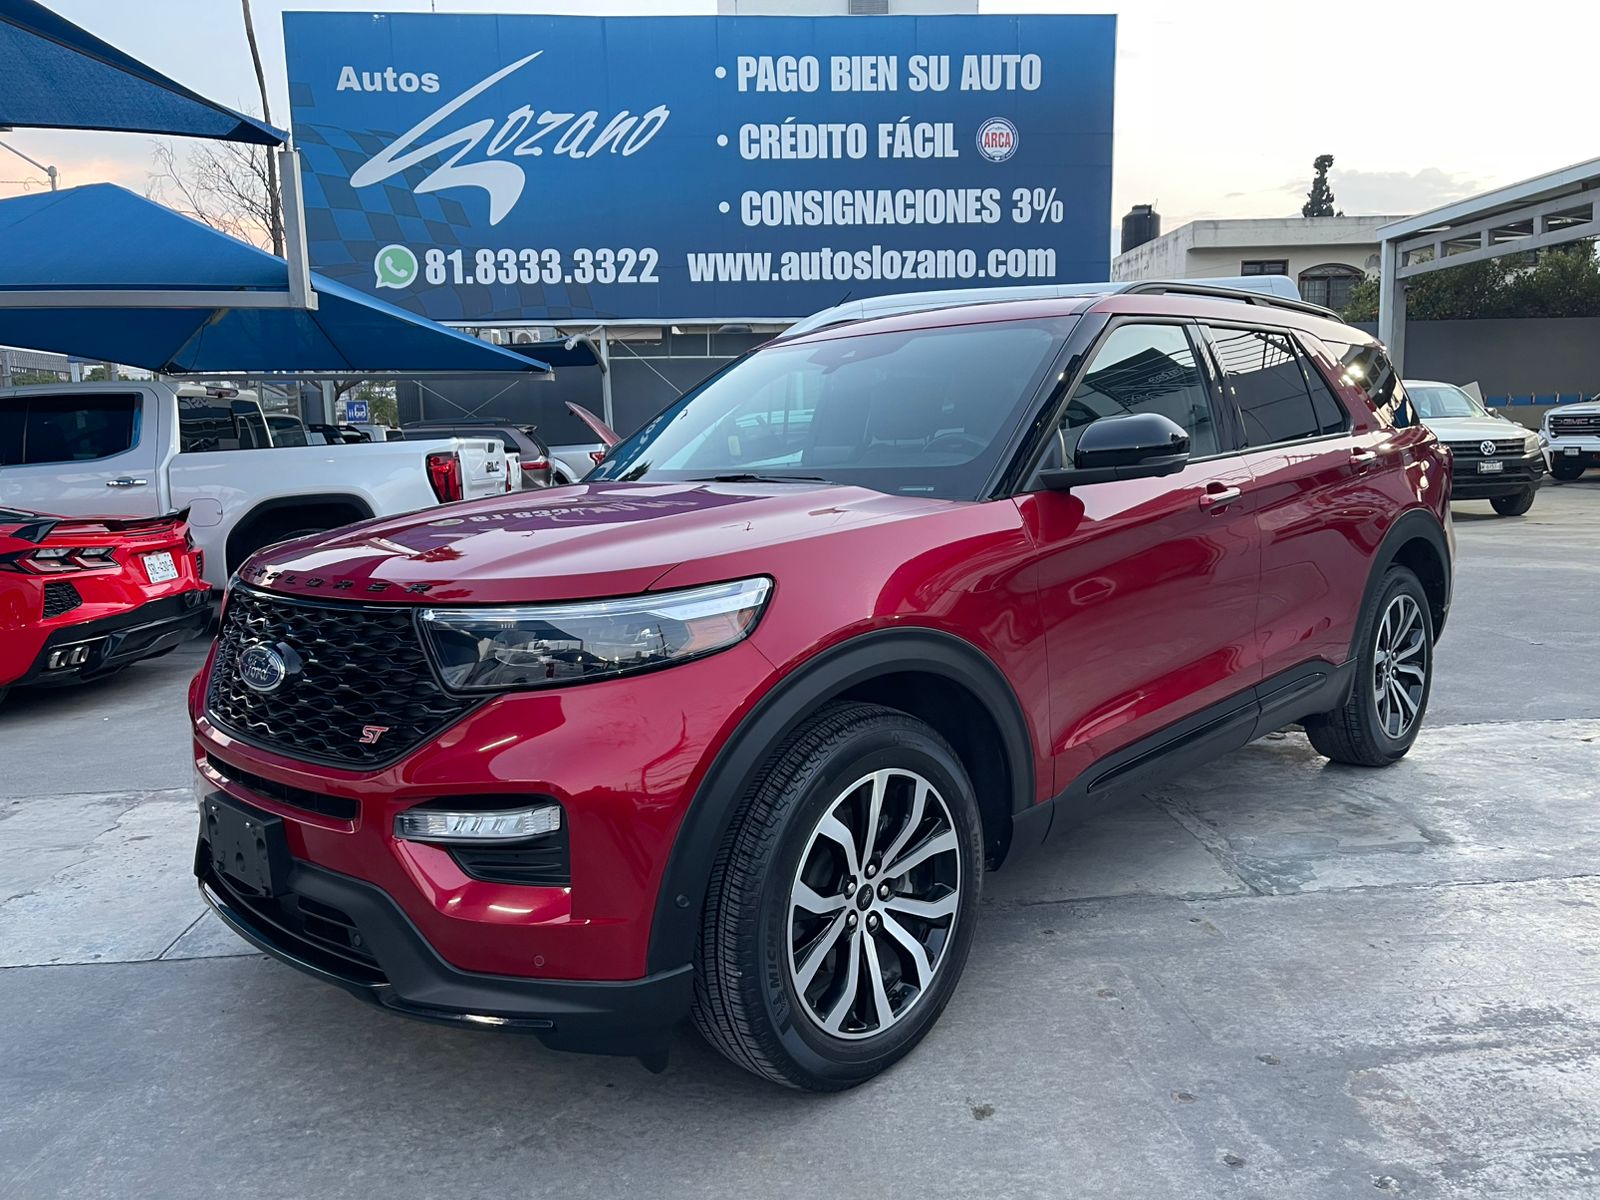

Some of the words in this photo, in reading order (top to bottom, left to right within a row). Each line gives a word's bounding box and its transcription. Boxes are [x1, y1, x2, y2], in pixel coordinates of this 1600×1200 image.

[337, 66, 440, 93] Autos
[737, 55, 820, 92] PAGO
[831, 55, 898, 92] BIEN
[908, 55, 950, 92] SU
[960, 54, 1042, 91] AUTO
[350, 50, 670, 226] Lozano
[739, 116, 867, 160] CRÉDITO
[878, 116, 958, 159] FÁCIL
[984, 132, 1011, 148] ARCA
[741, 188, 1001, 227] CONSIGNACIONES
[1012, 187, 1064, 224] 3%
[424, 247, 660, 285] 81.8333.3322
[687, 245, 1056, 282] www.autoslozano.com
[242, 650, 278, 684] Ford
[358, 725, 390, 744] ST
